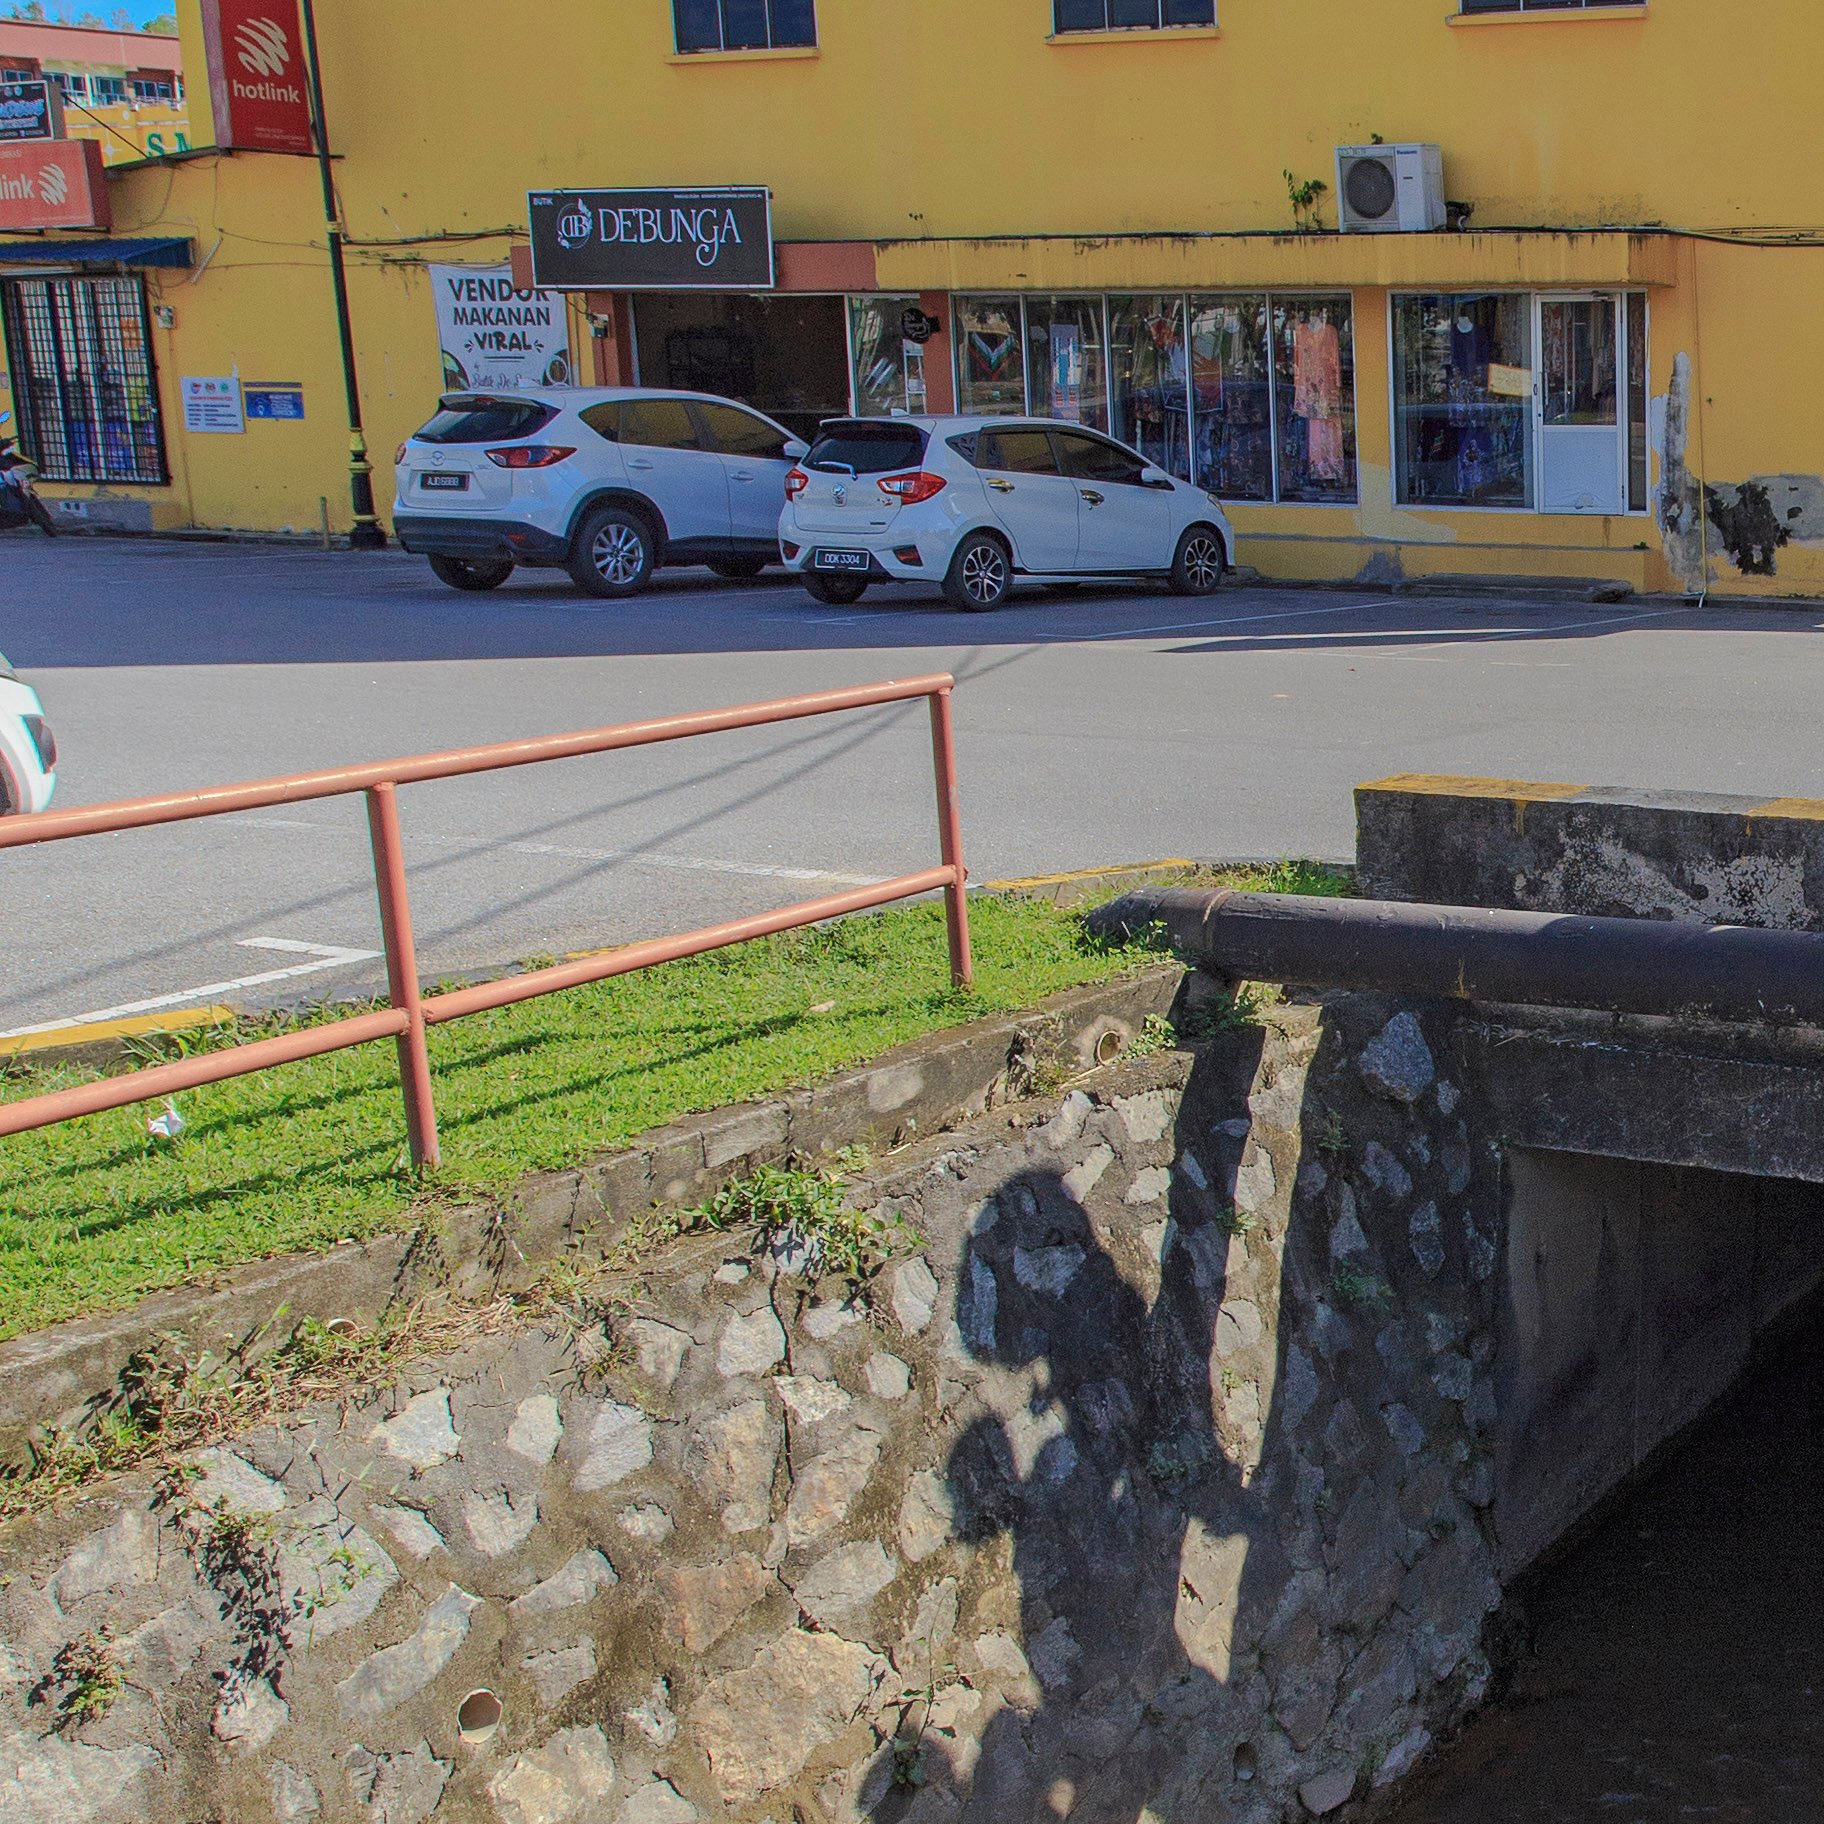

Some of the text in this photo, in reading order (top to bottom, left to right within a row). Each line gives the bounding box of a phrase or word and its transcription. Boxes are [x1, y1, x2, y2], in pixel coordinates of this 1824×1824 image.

[232, 79, 301, 104] hotlink
[453, 306, 551, 326] MAKANAN
[473, 331, 533, 352] VIRAL
